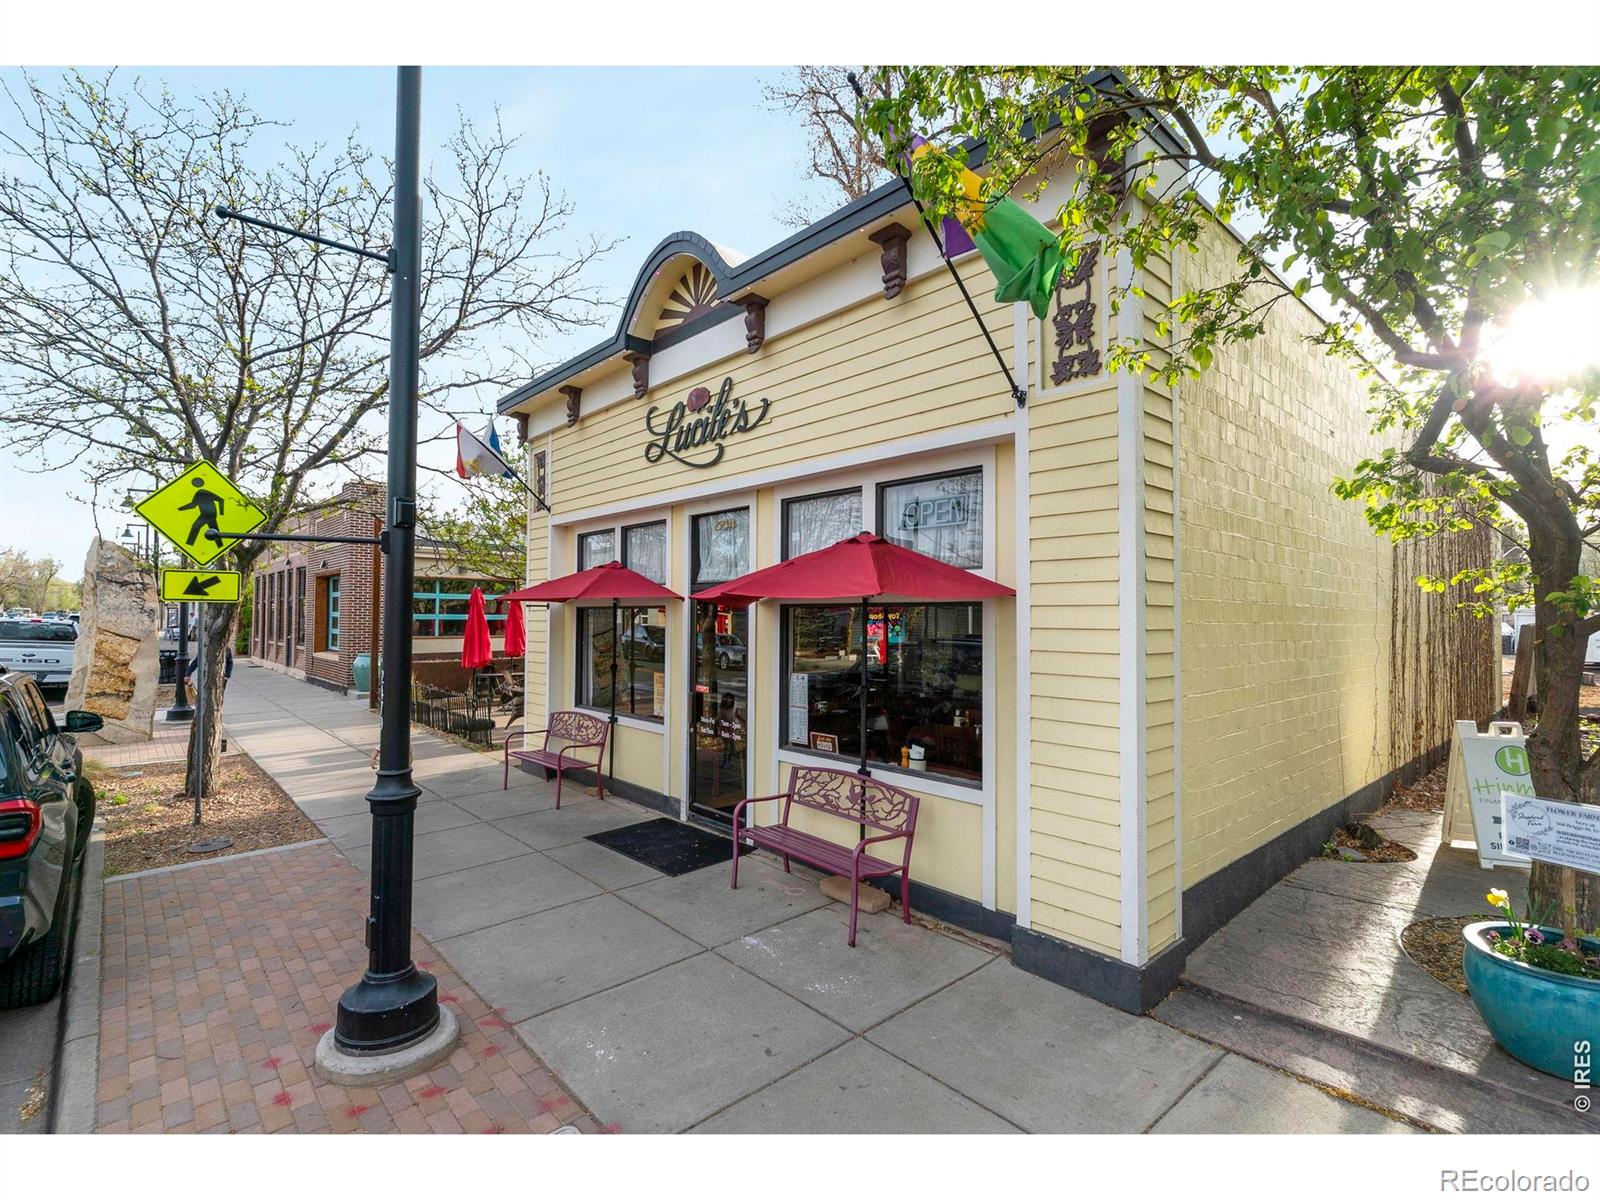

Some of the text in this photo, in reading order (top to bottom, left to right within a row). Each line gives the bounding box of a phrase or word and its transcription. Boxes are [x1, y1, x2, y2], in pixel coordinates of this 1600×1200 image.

[645, 376, 770, 468] Lucile's
[906, 499, 964, 526] OPEN
[1546, 806, 1577, 817] FLOWER
